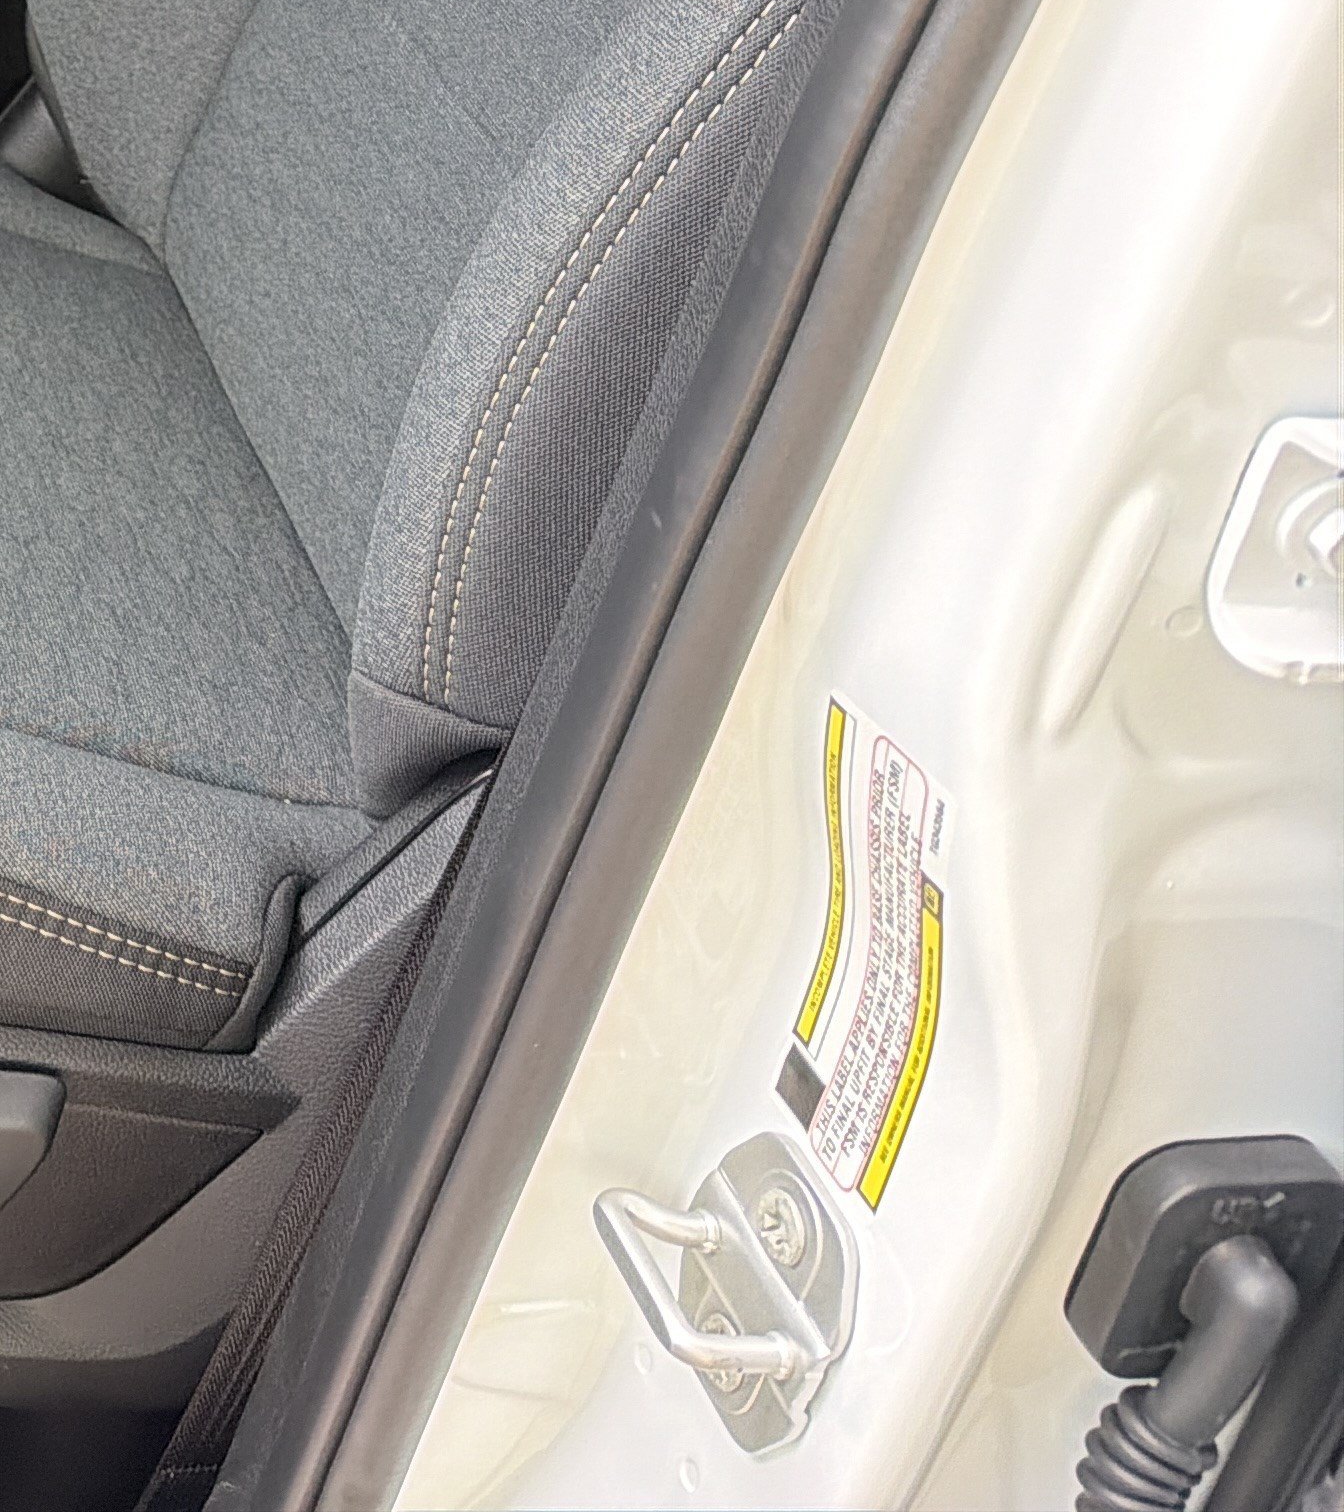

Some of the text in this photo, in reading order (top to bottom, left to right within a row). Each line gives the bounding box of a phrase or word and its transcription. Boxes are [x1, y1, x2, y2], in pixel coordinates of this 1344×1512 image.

[871, 769, 885, 818] PRIOR
[869, 820, 882, 886] CHASSIS
[822, 759, 903, 1161] TO FINAL UPFIT BY FINAL STAGE MANUFACTURER (FSM)
[841, 1120, 860, 1157] FSM
[856, 1101, 868, 1124] IS
[862, 1001, 899, 1106] RESPONSIBLE
[897, 812, 910, 859] LABEL
[849, 990, 873, 1055] APPLIES
[831, 1055, 854, 1101] LABEL
[859, 1053, 899, 1157] INFORMATION
[816, 1099, 836, 1136] THIS
